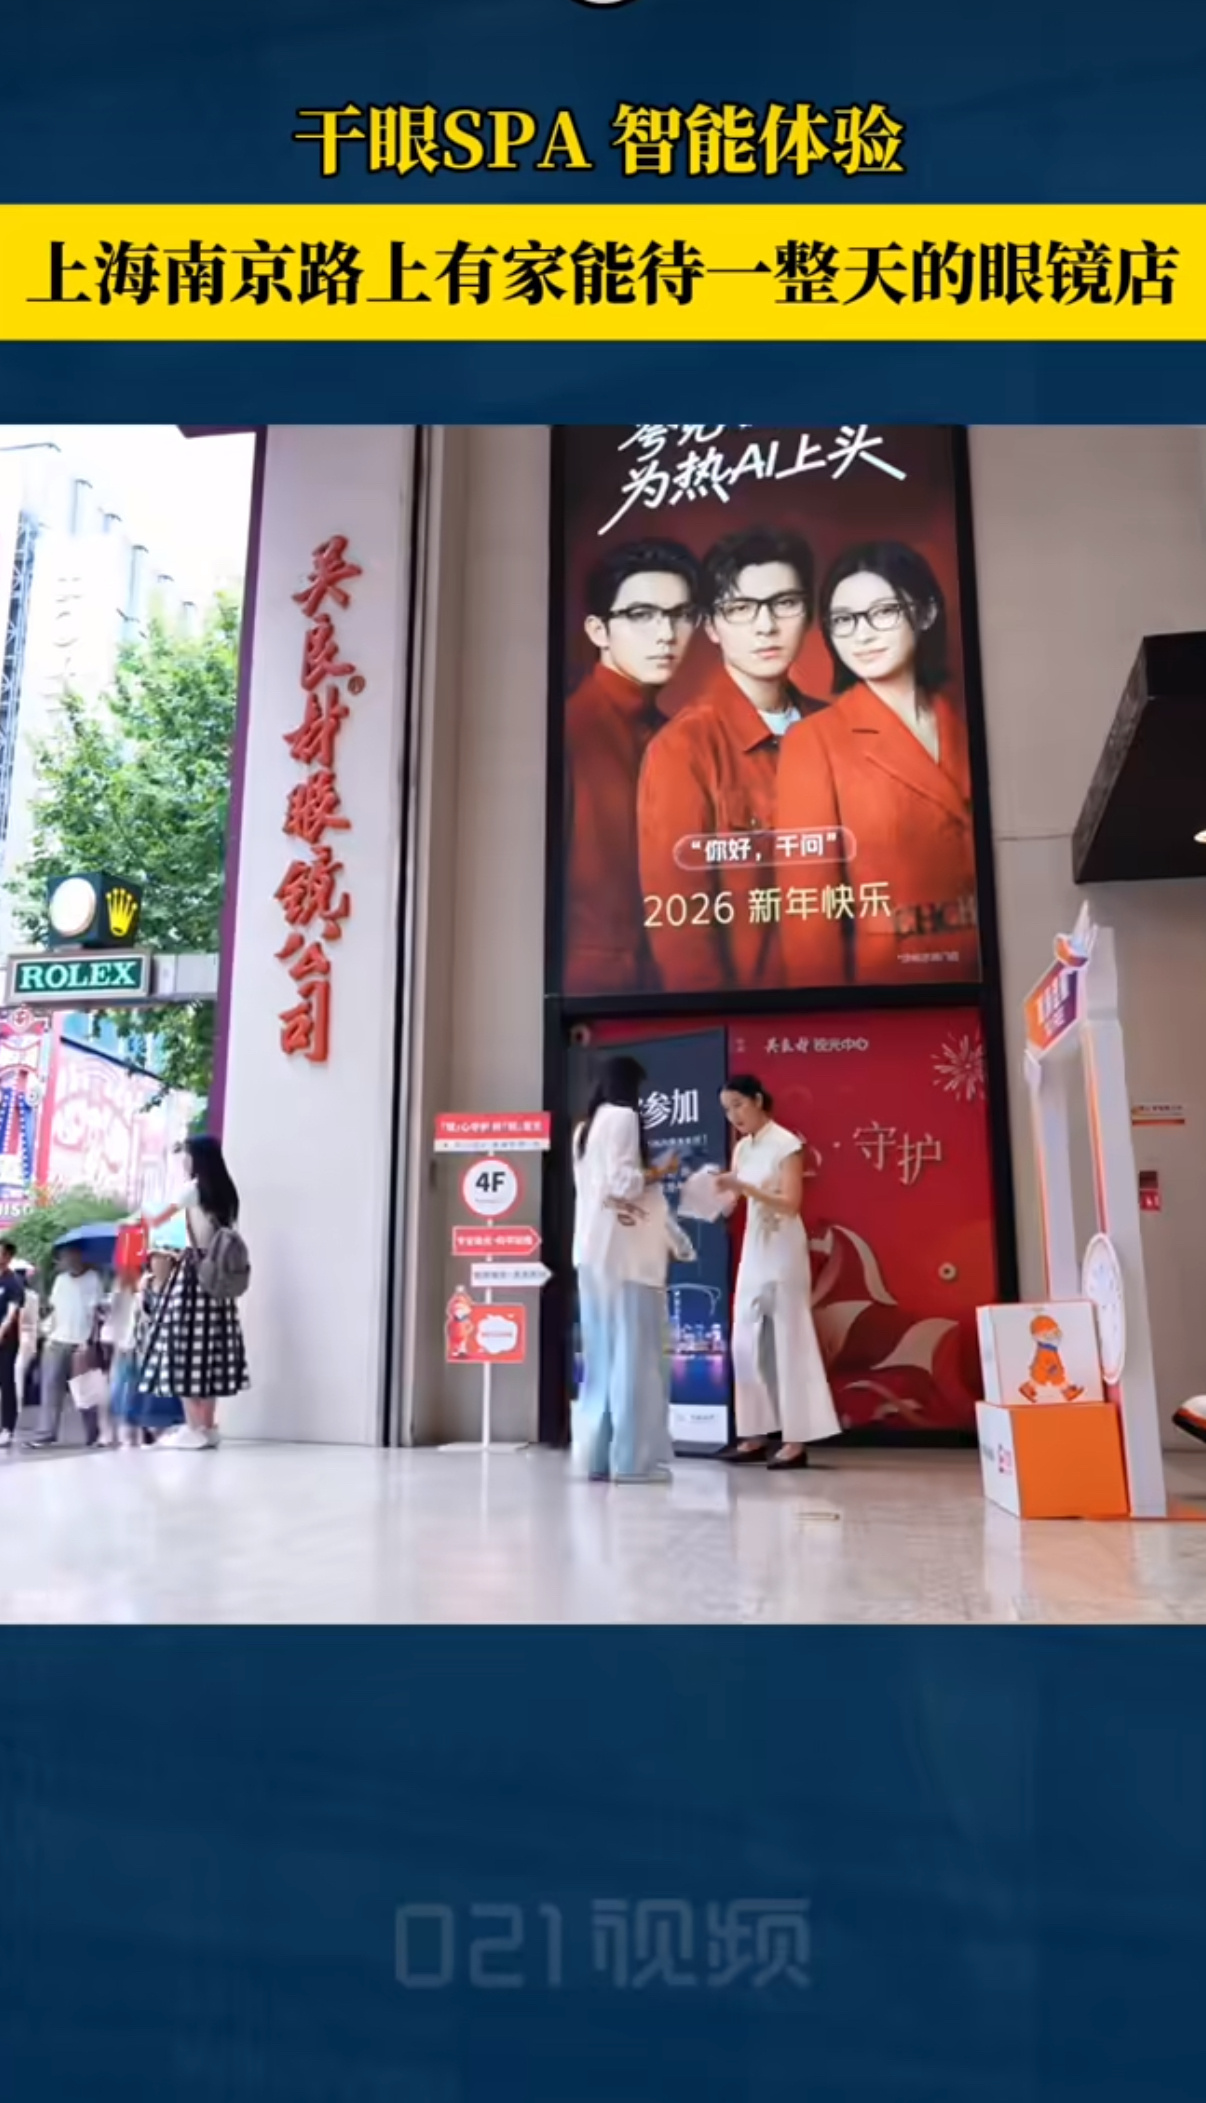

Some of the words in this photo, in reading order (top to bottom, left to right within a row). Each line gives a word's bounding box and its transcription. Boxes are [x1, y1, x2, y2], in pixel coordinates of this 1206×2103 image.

[598, 425, 907, 535] 为热AI上头
[643, 891, 735, 928] 2026
[748, 881, 892, 924] 新年快乐
[19, 961, 136, 989] ROLEX
[638, 1088, 699, 1129] 参加
[475, 1171, 506, 1192] 4F
[0, 1203, 34, 1217] ISO
